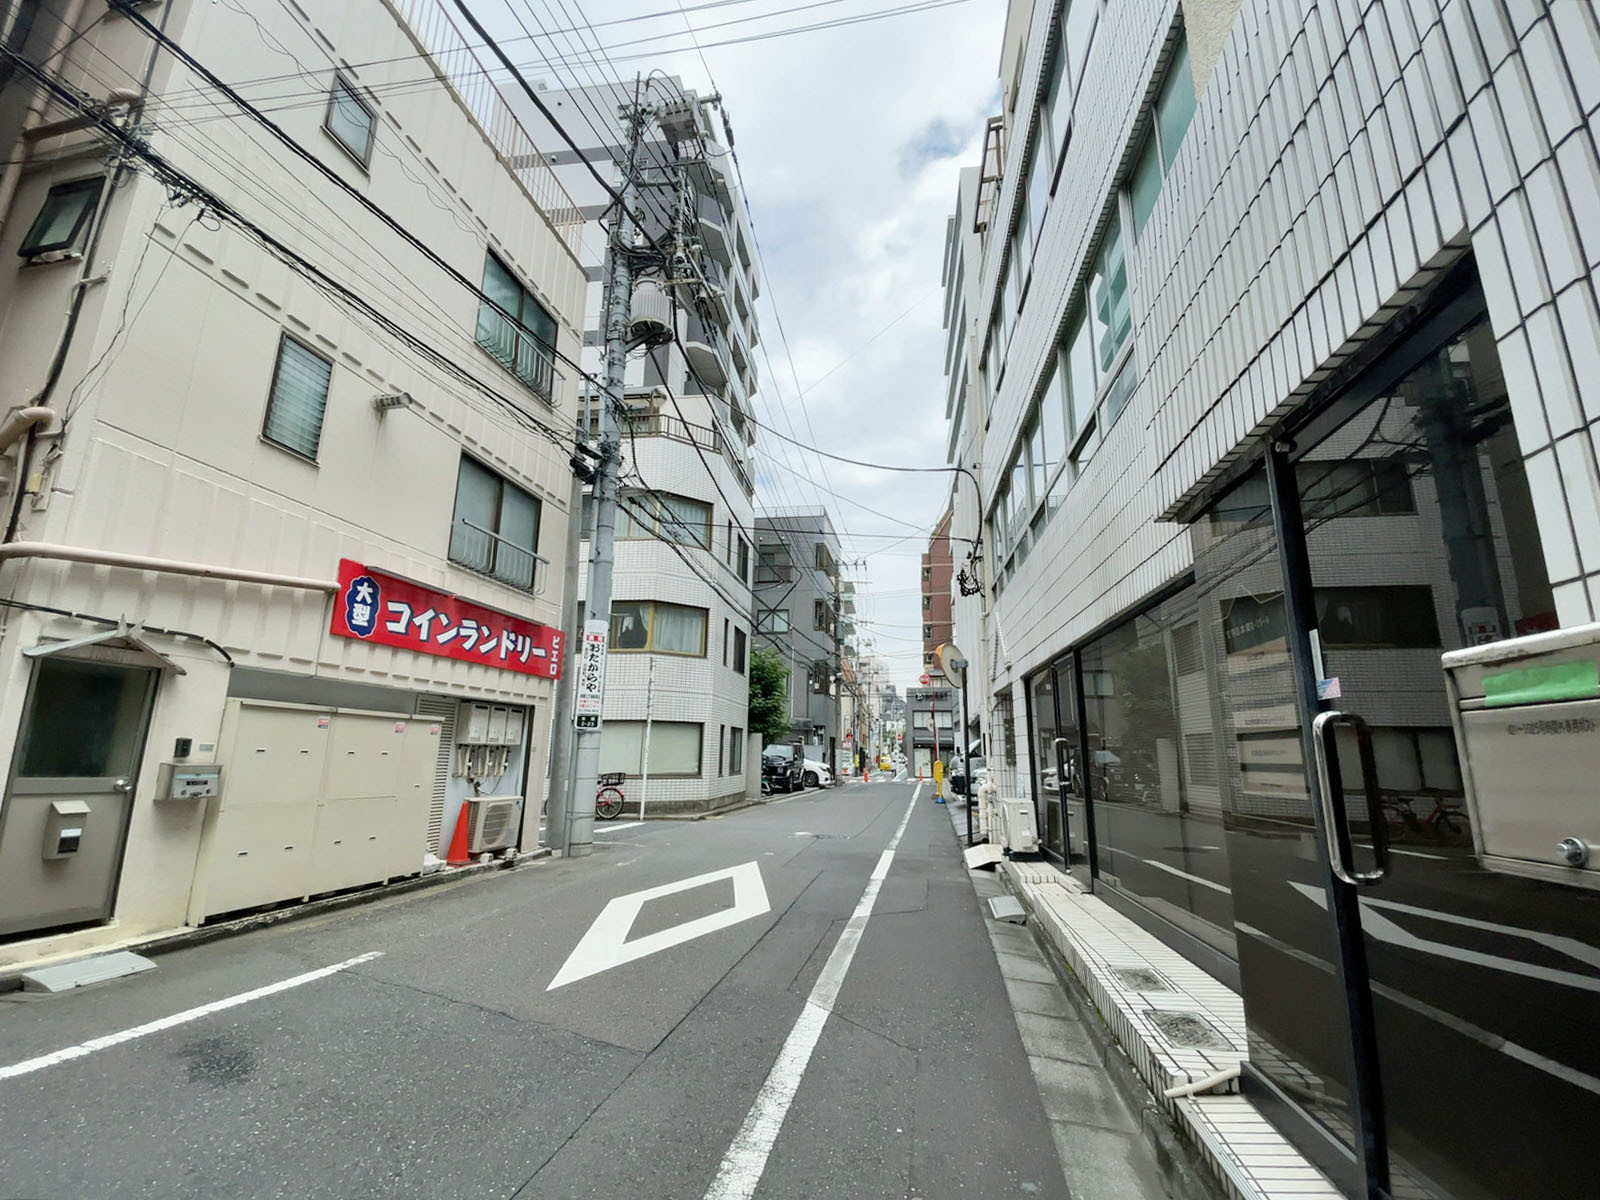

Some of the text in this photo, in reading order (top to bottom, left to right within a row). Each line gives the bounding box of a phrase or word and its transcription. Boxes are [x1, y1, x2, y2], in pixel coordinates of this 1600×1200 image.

[351, 581, 374, 628] 大型
[386, 600, 547, 664] コインランドリー
[586, 643, 600, 692] おたからや
